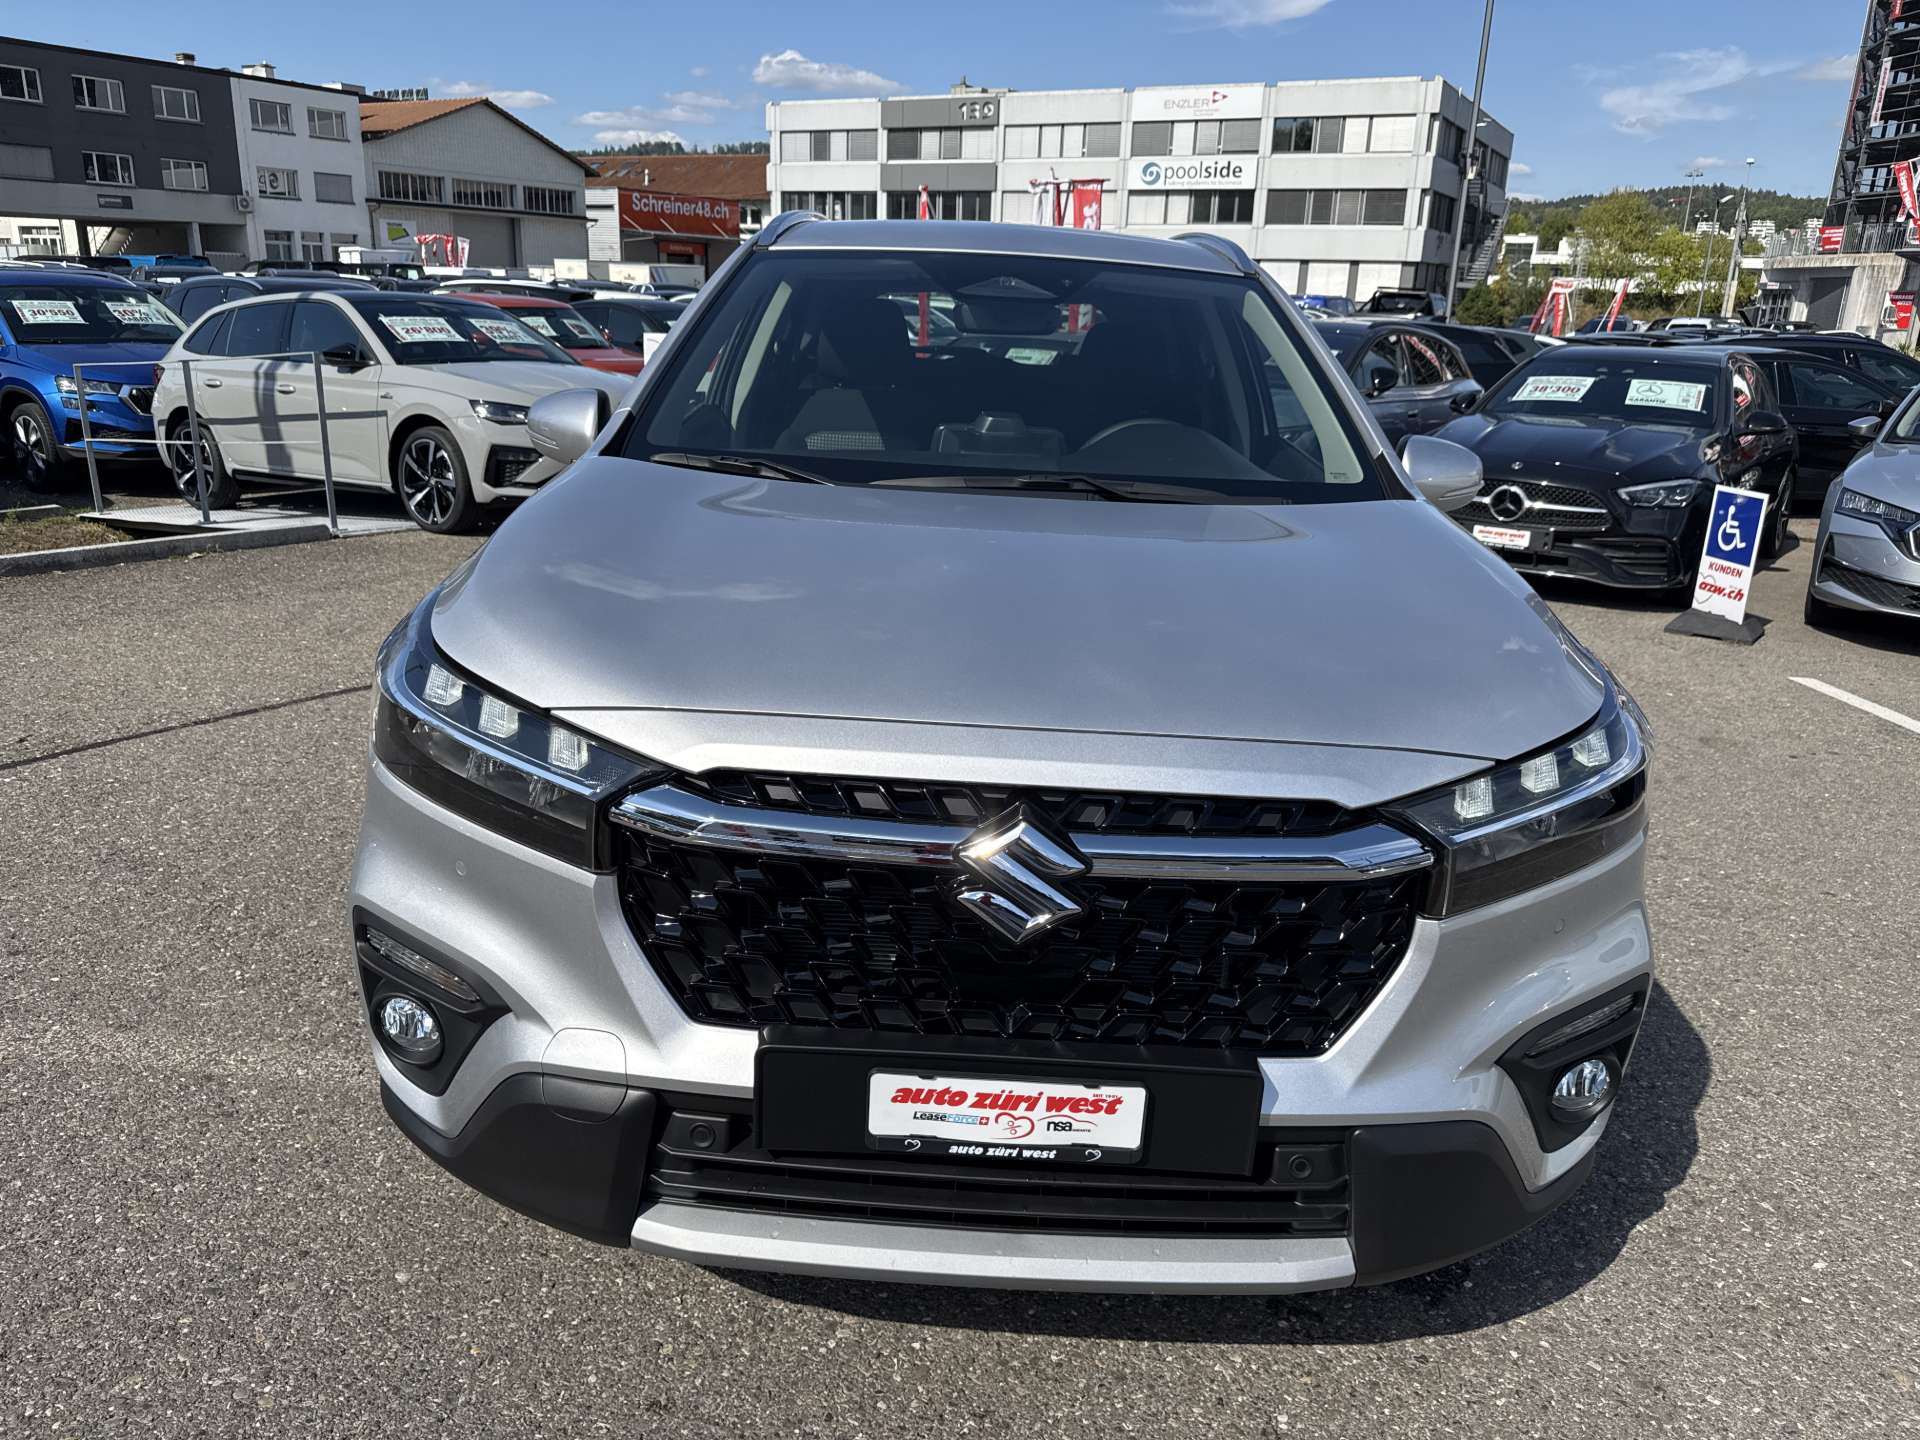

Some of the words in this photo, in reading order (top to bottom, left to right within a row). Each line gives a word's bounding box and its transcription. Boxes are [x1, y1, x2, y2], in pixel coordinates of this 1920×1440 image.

[958, 102, 994, 120] 139
[1163, 98, 1210, 109] ENZLER
[1164, 160, 1243, 186] poolside
[632, 192, 730, 219] Schreiner48.ch
[1708, 561, 1743, 578] KUNDEN
[1698, 581, 1744, 601] azw.ch
[890, 1086, 968, 1107] auto
[968, 1089, 1044, 1112] züri
[1045, 1094, 1124, 1115] west
[912, 1111, 979, 1125] LeaseForce
[1046, 1121, 1072, 1132] nsa
[948, 1145, 984, 1155] auto
[985, 1146, 1020, 1157] züri
[1022, 1149, 1057, 1159] west
